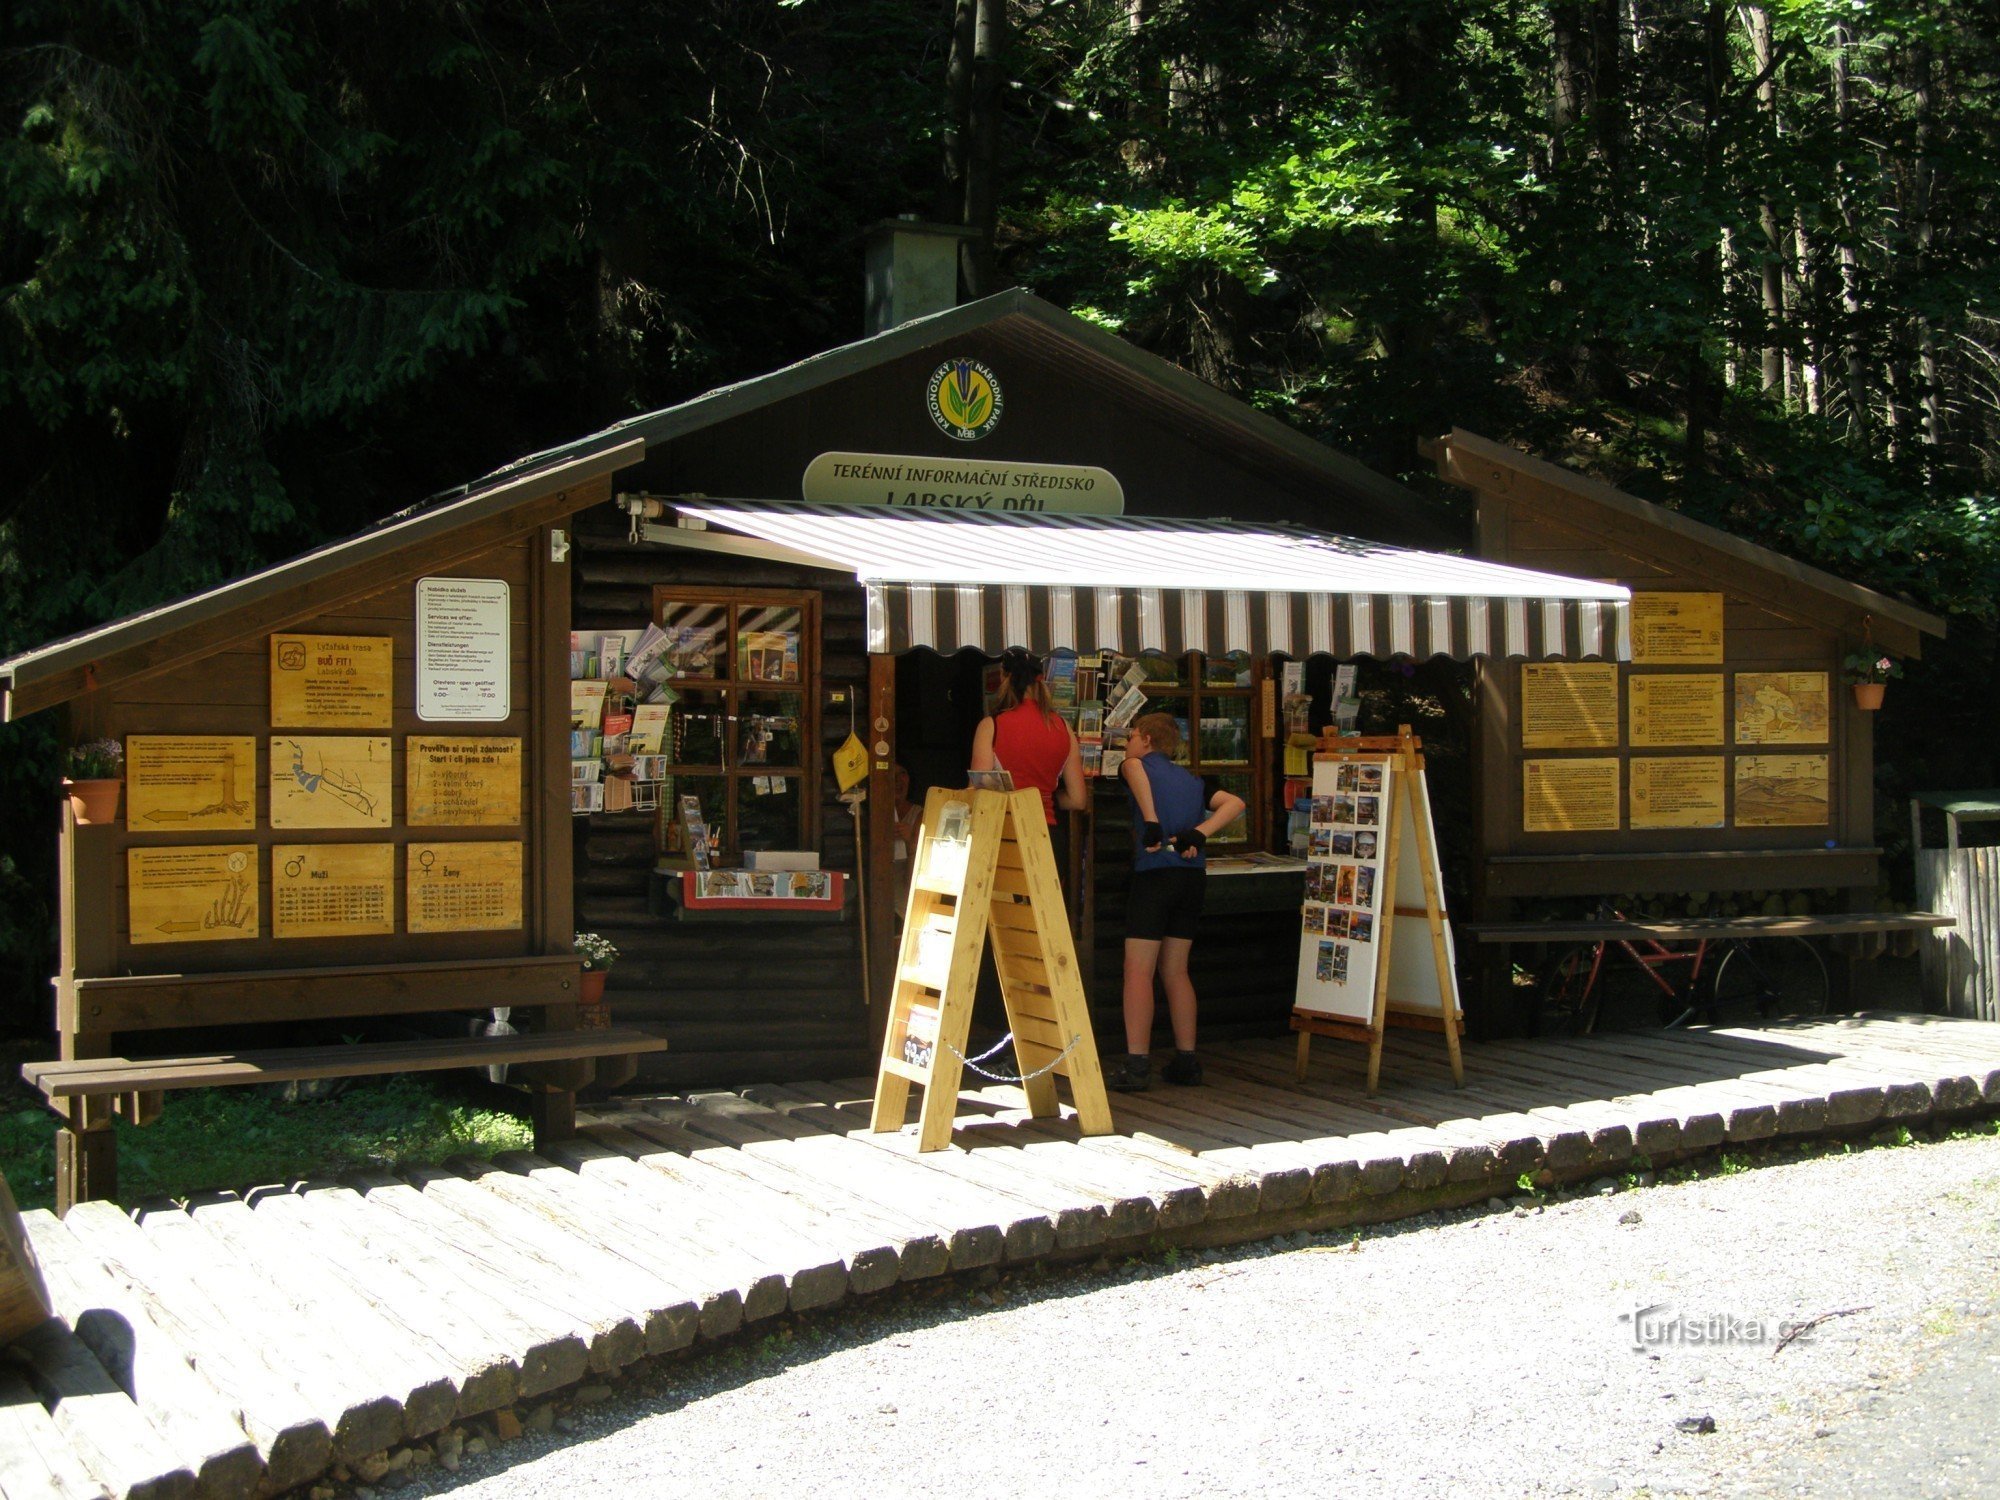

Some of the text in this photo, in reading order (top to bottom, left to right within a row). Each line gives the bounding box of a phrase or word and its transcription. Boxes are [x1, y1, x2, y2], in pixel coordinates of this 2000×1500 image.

[930, 362, 950, 430] KRKONOŠSKÝ
[975, 363, 1004, 431] NÁRODNÍ PARK
[833, 463, 1095, 491] TERÉNNÍ INFORMAČNÍ STŘEDISKO
[317, 642, 372, 653] Lyžařská trasa
[420, 744, 450, 753] Prověřte
[452, 744, 460, 753] si
[461, 745, 478, 756] svoji
[429, 755, 447, 763] Start
[464, 756, 480, 765] jsou
[311, 870, 329, 879] Muži
[443, 865, 460, 878] Ženy
